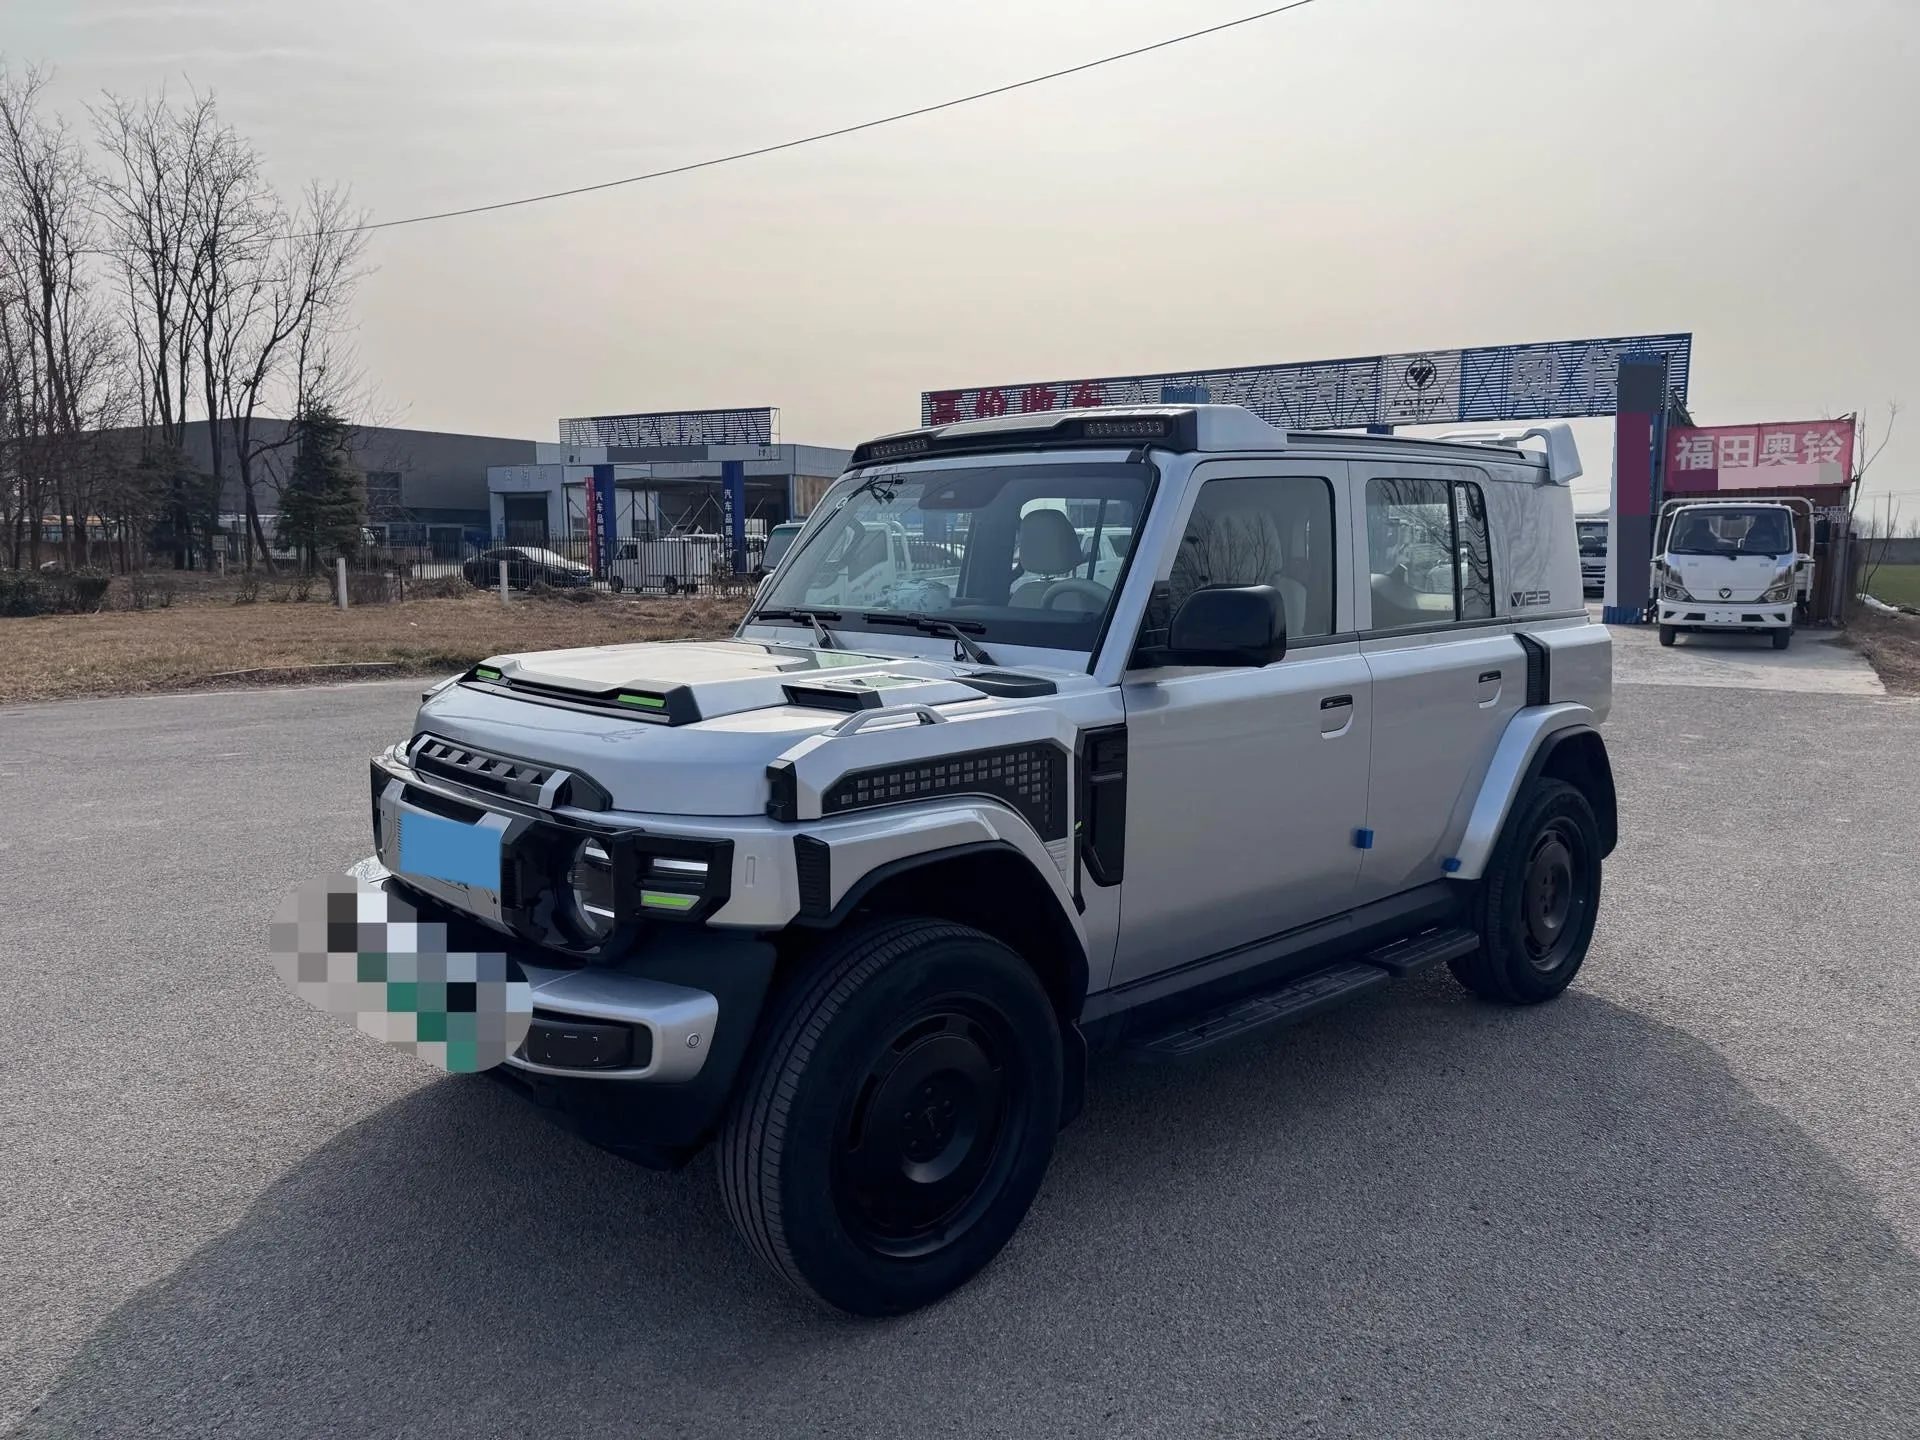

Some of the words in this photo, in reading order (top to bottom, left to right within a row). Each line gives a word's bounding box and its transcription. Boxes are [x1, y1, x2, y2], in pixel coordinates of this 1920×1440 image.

[612, 419, 702, 443] 上汽通用
[1675, 429, 1844, 471] 福田奥铃
[1511, 590, 1551, 607] V23
